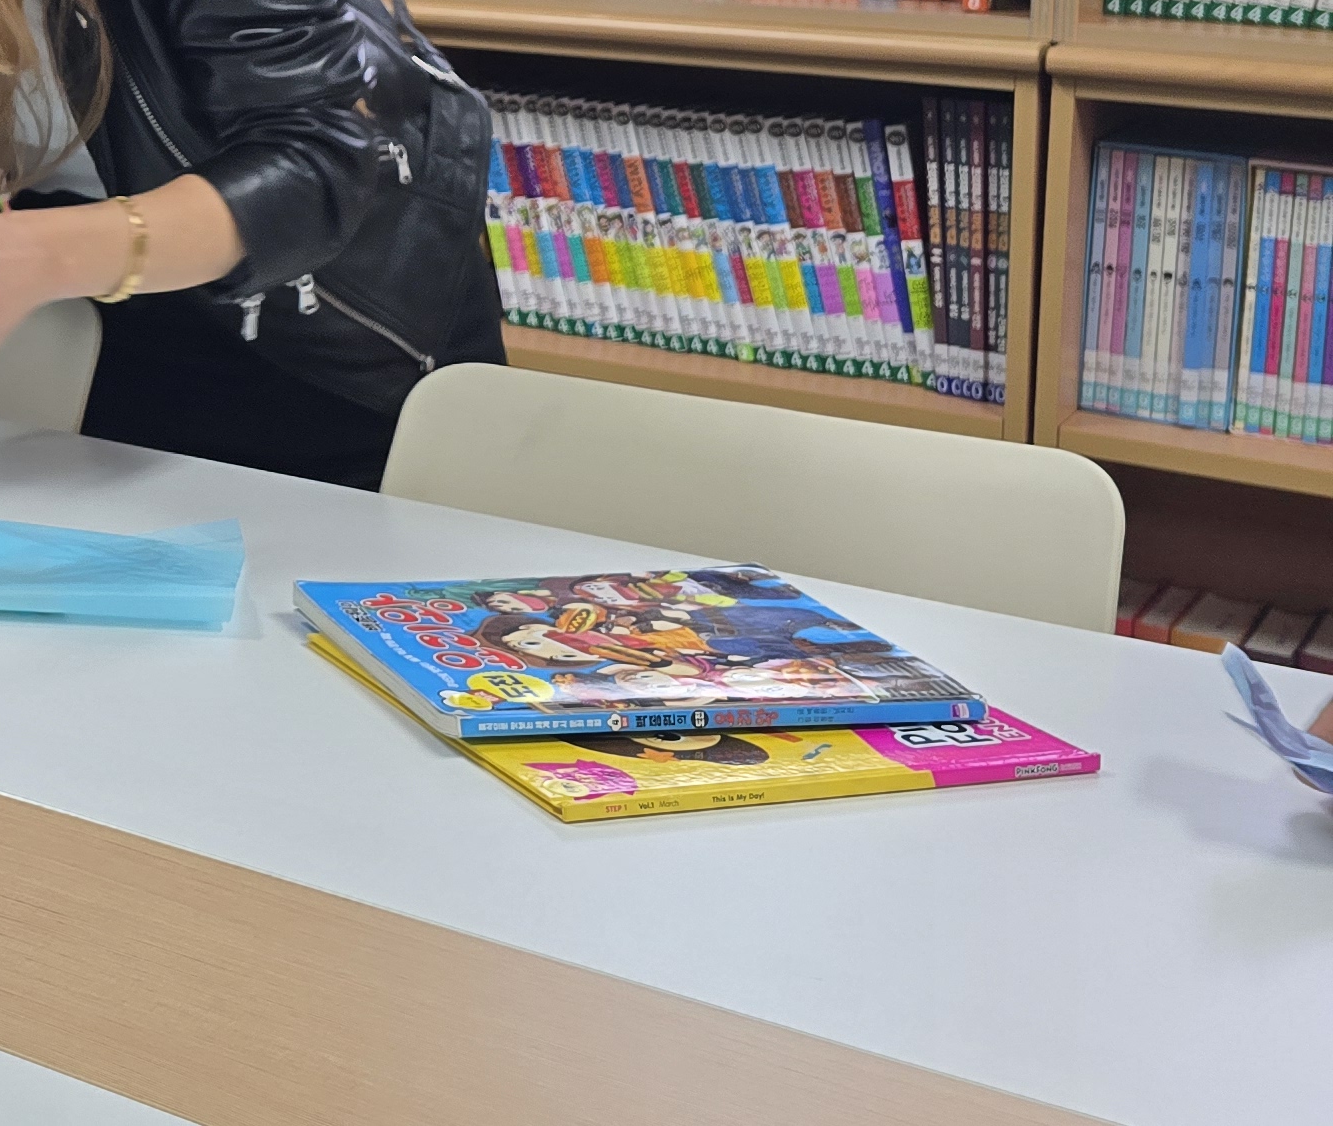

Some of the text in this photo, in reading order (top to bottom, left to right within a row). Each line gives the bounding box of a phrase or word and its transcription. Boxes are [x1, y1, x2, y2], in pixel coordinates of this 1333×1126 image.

[1130, 0, 1143, 14] 4
[1149, 0, 1163, 16] 4
[1171, 1, 1184, 18] 4
[1191, 3, 1204, 19] 4
[1213, 4, 1226, 20] 4
[1230, 5, 1244, 22] 4
[1247, 6, 1262, 23] 4
[1268, 7, 1283, 24] 4
[1290, 9, 1304, 25] 4
[1315, 12, 1330, 28] 4
[508, 308, 519, 324] 4
[527, 310, 538, 326] 4
[543, 313, 553, 330] 4
[558, 316, 569, 333] 4
[574, 319, 586, 335] 4
[592, 321, 603, 337] 4
[606, 324, 617, 339] 4
[624, 325, 635, 341] 4
[641, 330, 652, 345] 4
[654, 331, 665, 347] 4
[670, 334, 681, 350] 4
[691, 336, 702, 352] 4
[707, 338, 718, 354] 4
[725, 341, 736, 357] 4
[756, 346, 768, 362] 4
[773, 350, 784, 366] 4
[791, 352, 802, 368] 4
[807, 355, 818, 370] 4
[825, 356, 836, 372] 4
[843, 359, 855, 375] 4
[862, 361, 873, 377] 4
[879, 362, 890, 378] 4
[897, 366, 908, 382] 4
[361, 593, 527, 671] 요리왕
[483, 675, 540, 698] 도전
[714, 709, 779, 726] 요리왕
[1015, 764, 1058, 776] PINKFONG
[712, 795, 726, 803] This
[736, 794, 747, 802] My
[748, 792, 765, 801] Day!
[605, 805, 622, 813] STEP
[659, 799, 679, 808] March
